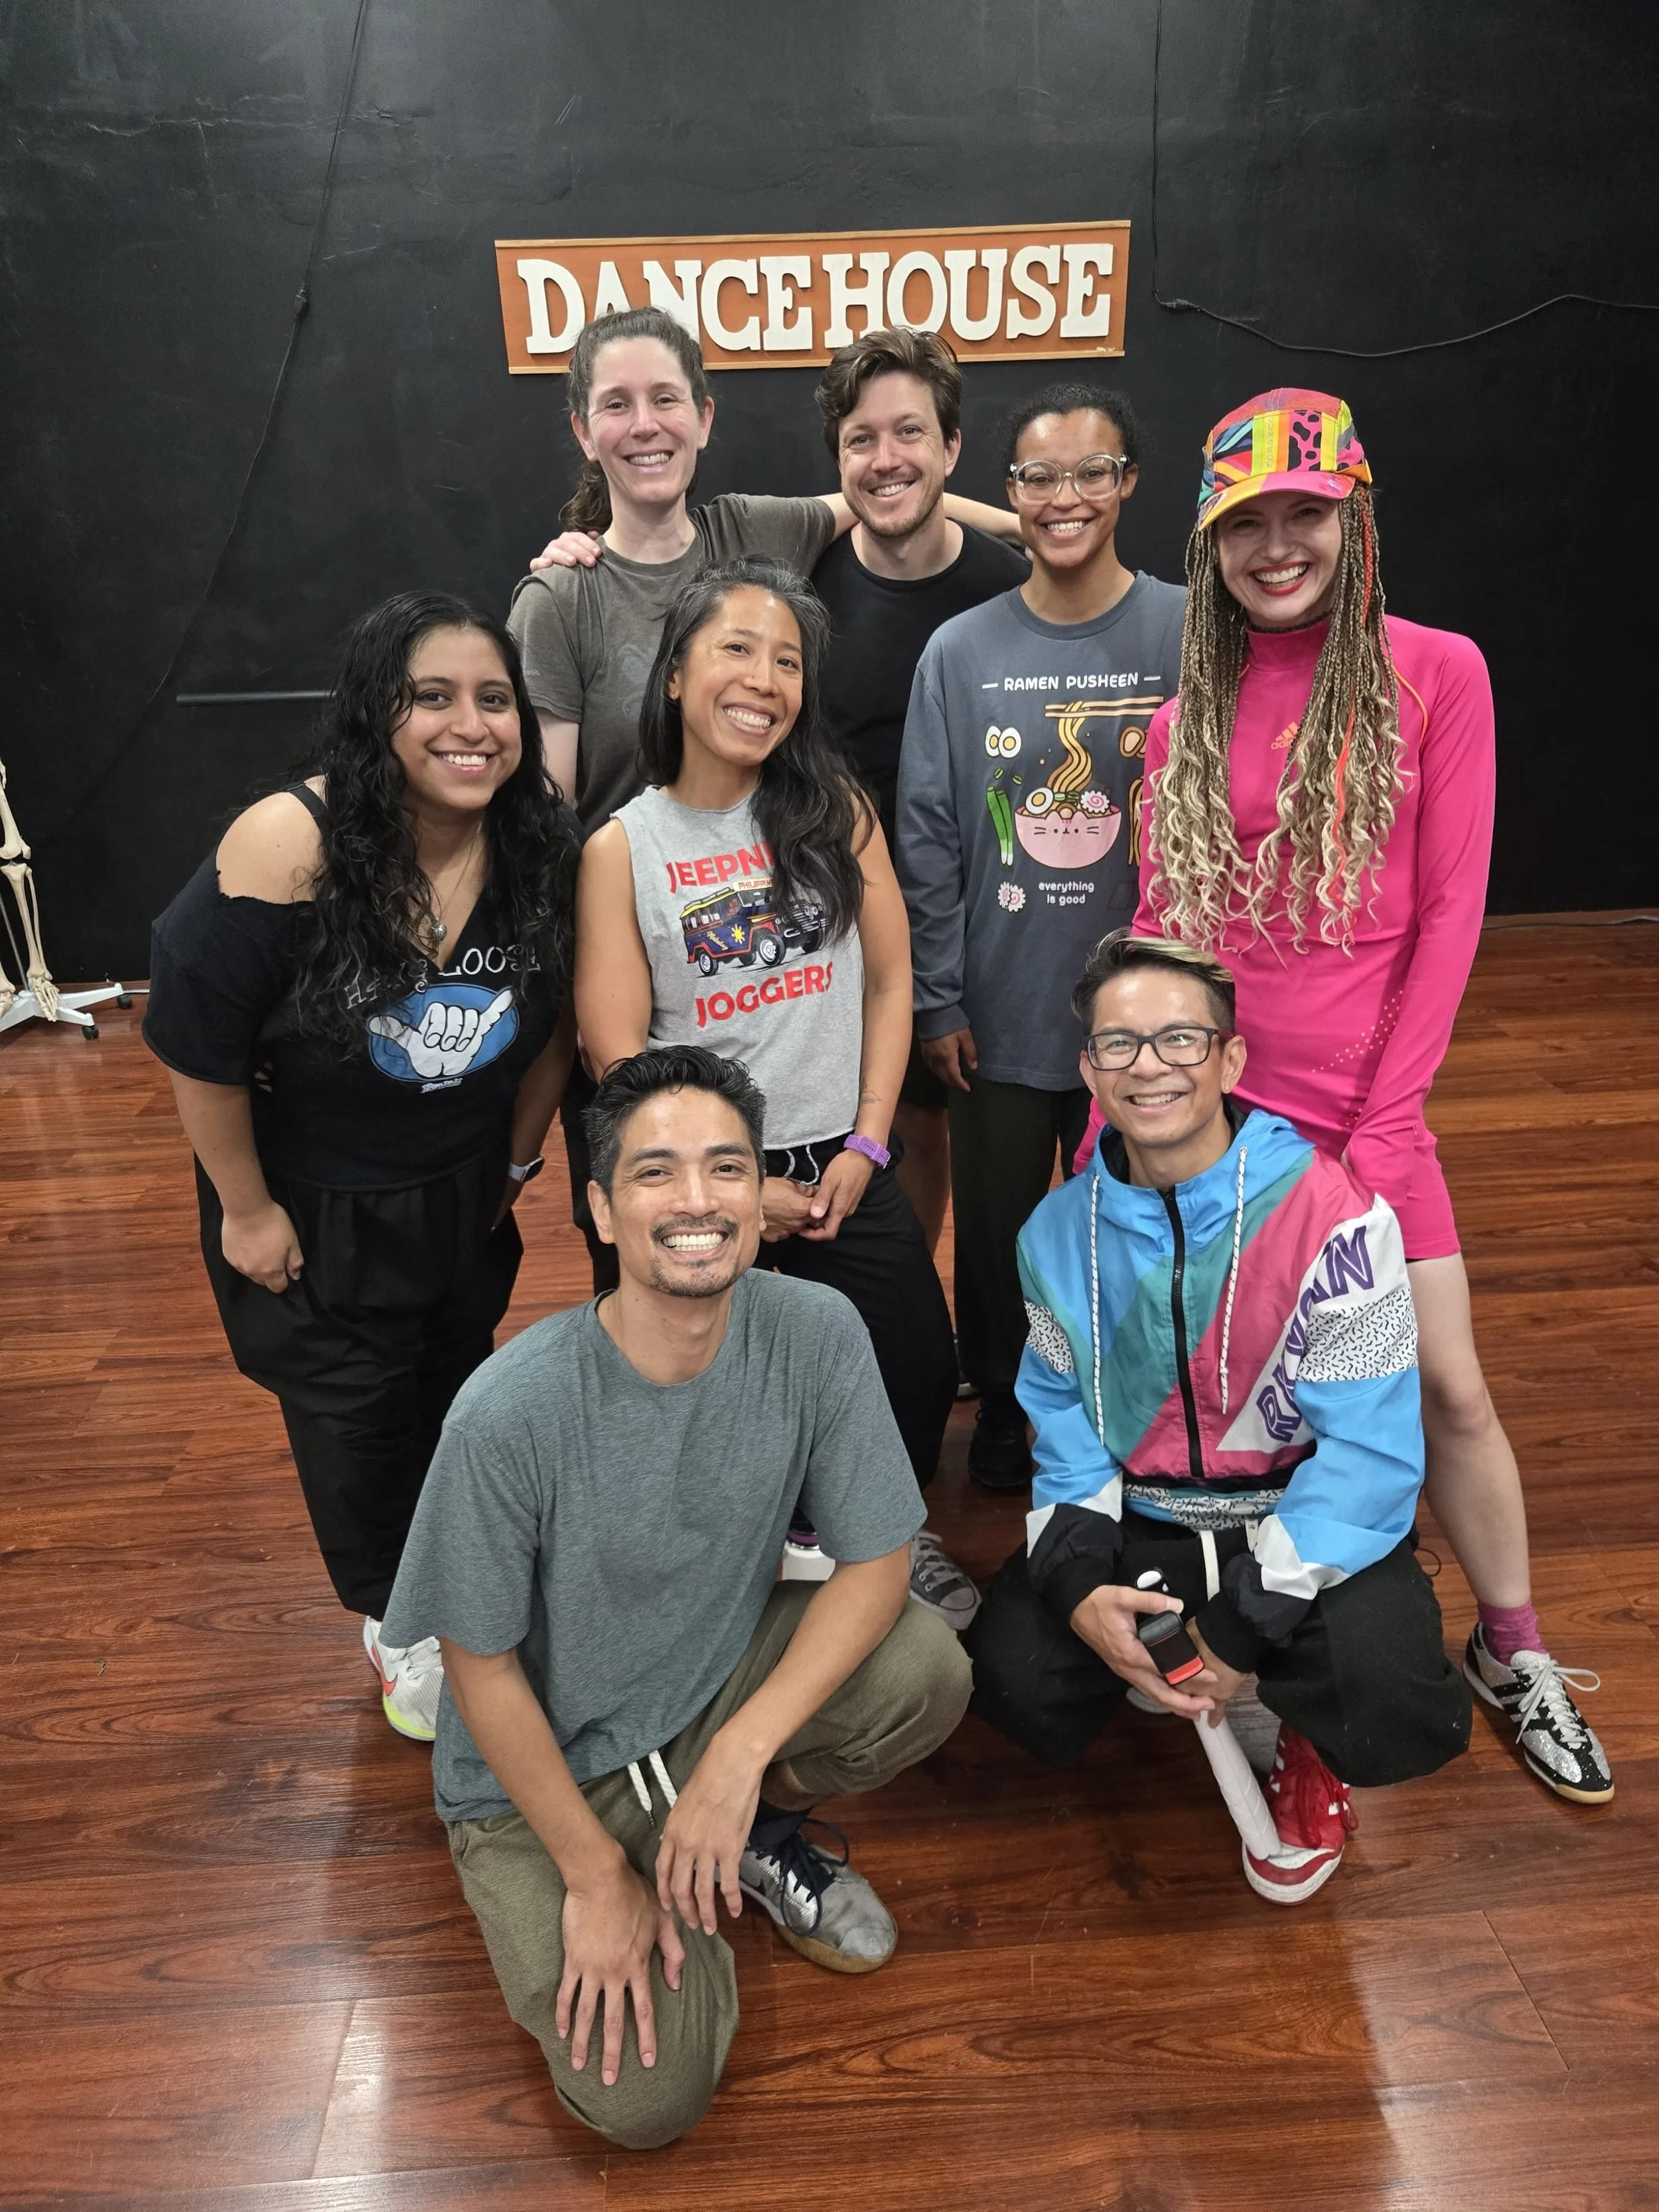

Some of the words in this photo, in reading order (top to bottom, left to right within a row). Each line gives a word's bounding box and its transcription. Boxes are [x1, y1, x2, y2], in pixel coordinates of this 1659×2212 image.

[1004, 676, 1059, 692] RAMEN
[1066, 672, 1139, 689] PUSHEEN
[666, 841, 775, 895] JEEPN
[1039, 881, 1094, 893] everything
[1059, 893, 1086, 905] good
[695, 961, 833, 1028] JOGGERS
